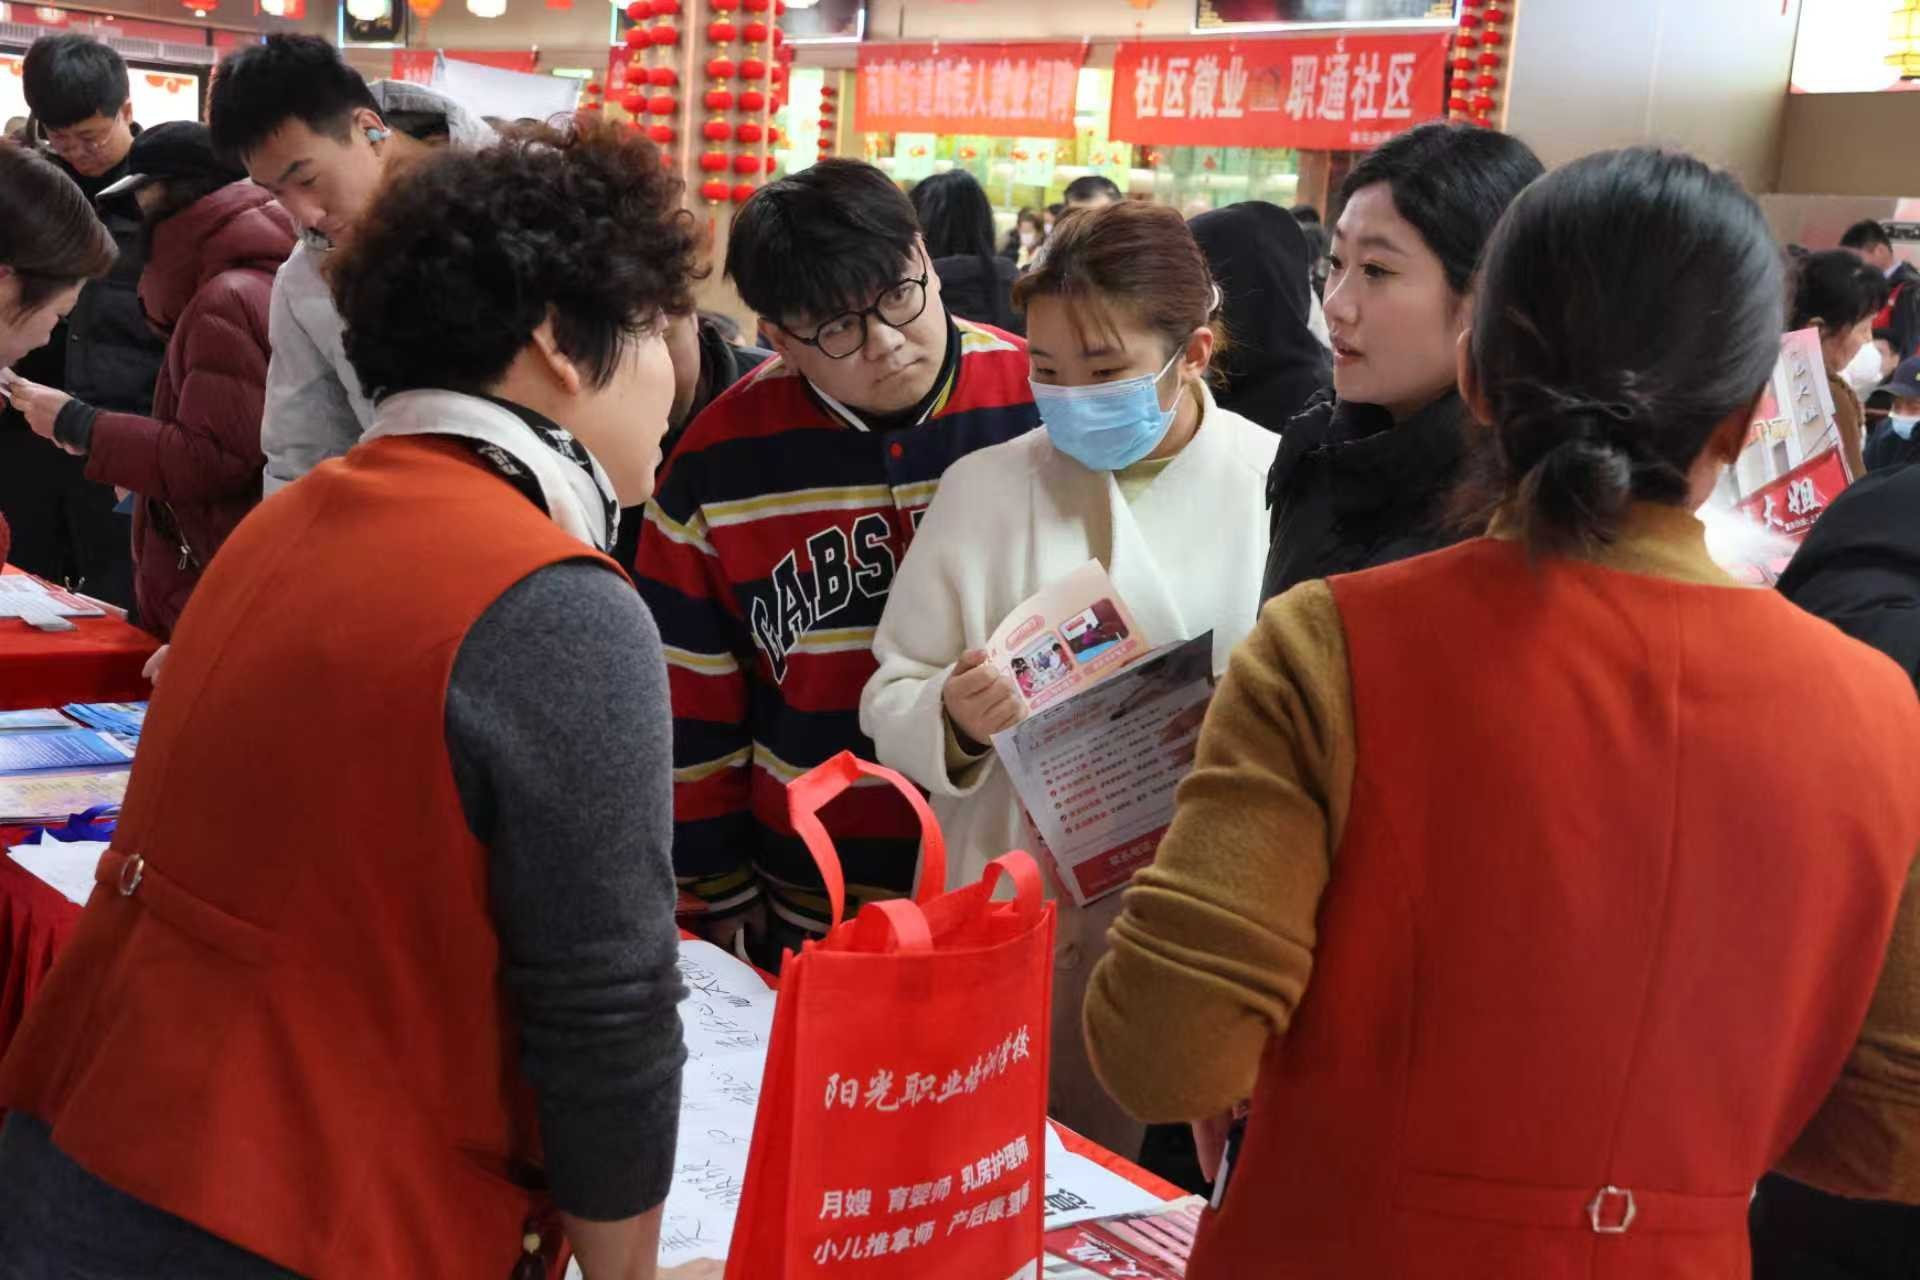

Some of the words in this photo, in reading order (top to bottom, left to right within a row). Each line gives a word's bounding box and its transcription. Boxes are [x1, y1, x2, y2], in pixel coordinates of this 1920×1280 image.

[1285, 52, 1416, 121] 职通社区
[824, 1025, 1029, 1111] 阳光职业培训学校
[819, 1188, 872, 1220] 月嫂
[888, 1176, 952, 1213] 育婴师
[961, 1136, 1029, 1194] 乳房护理师
[813, 1220, 936, 1265] 小儿推拿师
